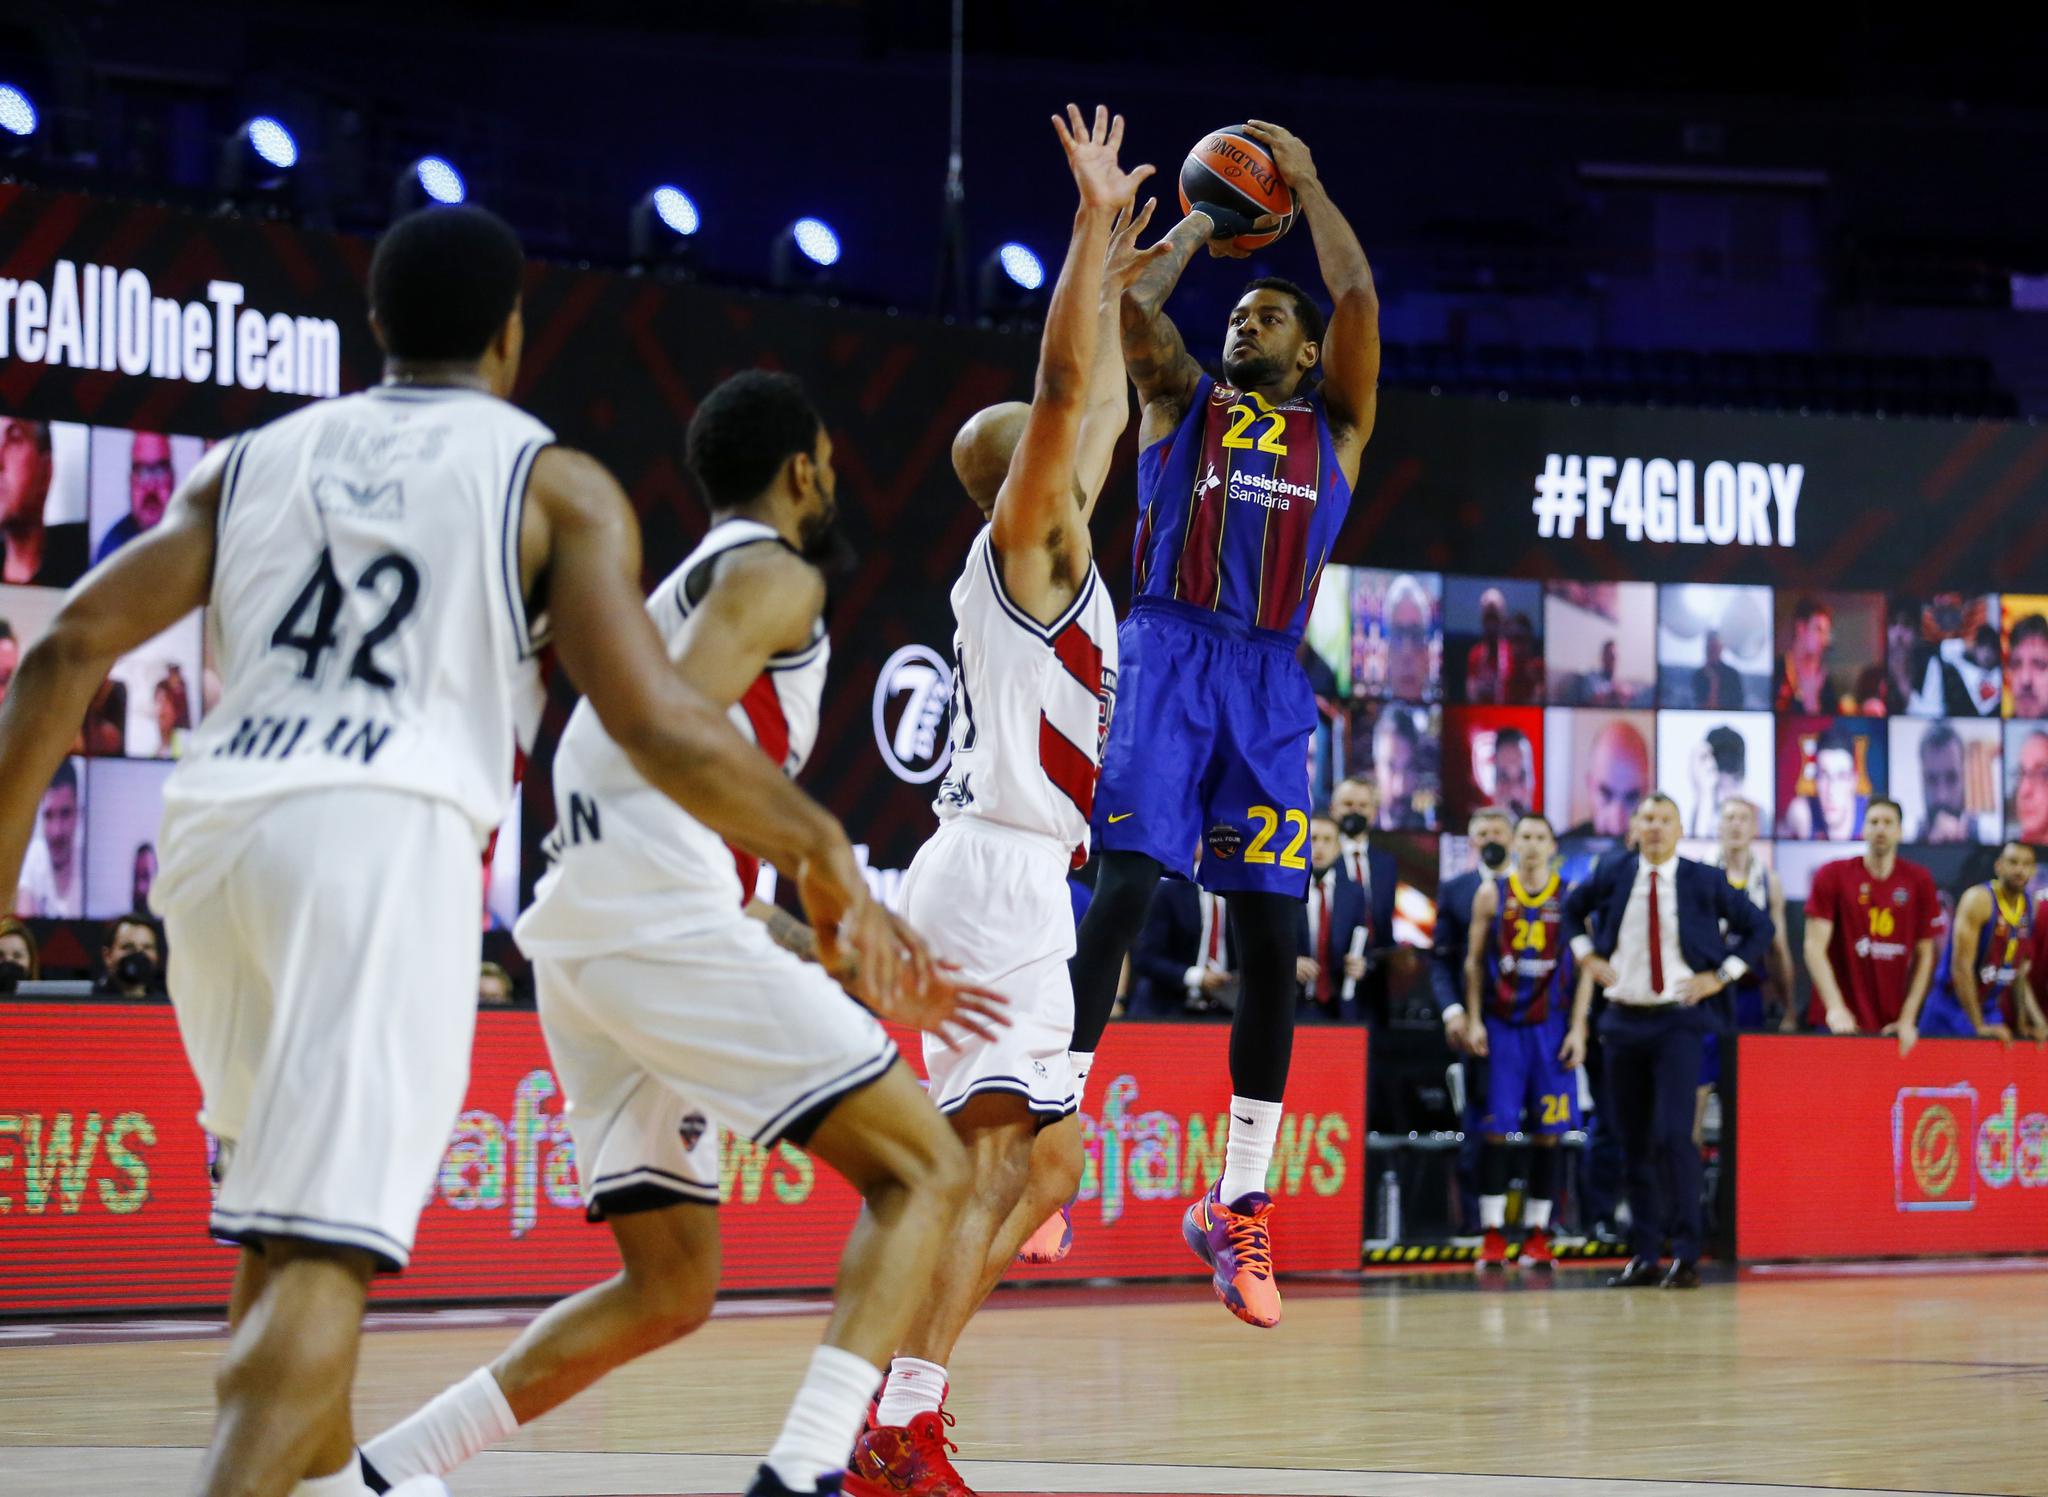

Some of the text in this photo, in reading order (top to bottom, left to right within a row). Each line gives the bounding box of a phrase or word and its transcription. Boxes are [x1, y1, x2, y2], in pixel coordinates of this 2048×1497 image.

[1222, 404, 1288, 456] 22
[1228, 484, 1290, 511] Sanitària
[1230, 469, 1318, 502] Assistència
[1532, 453, 1805, 548] #F4GLORY
[270, 544, 421, 690] 42
[1244, 805, 1308, 870] 22
[1868, 906, 1895, 937] 16
